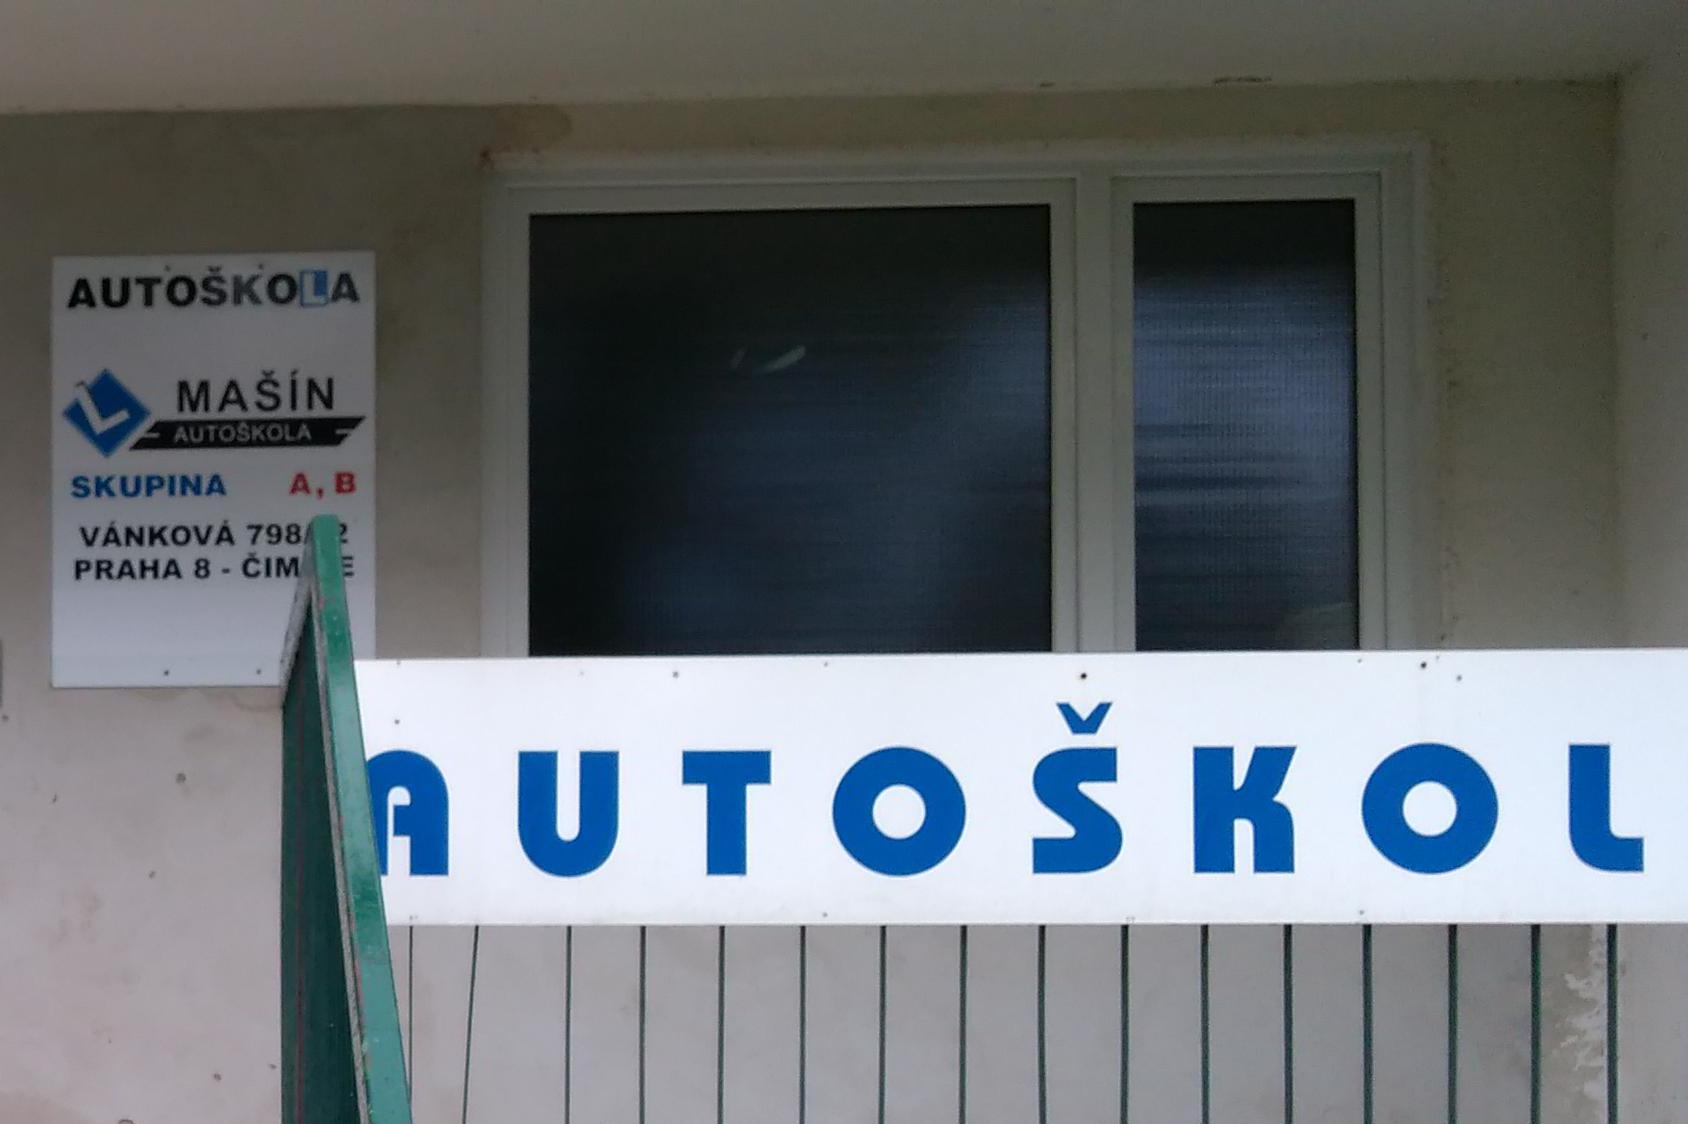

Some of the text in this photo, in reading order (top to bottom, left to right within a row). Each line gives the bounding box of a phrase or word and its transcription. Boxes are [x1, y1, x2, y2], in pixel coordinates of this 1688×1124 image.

[176, 370, 334, 413] MAŠÍN
[173, 422, 312, 444] AUTOŠKOLA
[71, 473, 227, 498] SKUPINA
[335, 471, 356, 494] B
[79, 520, 235, 548] VÁNKOVÁ
[74, 558, 183, 580] PRAHA
[193, 558, 211, 579] 8
